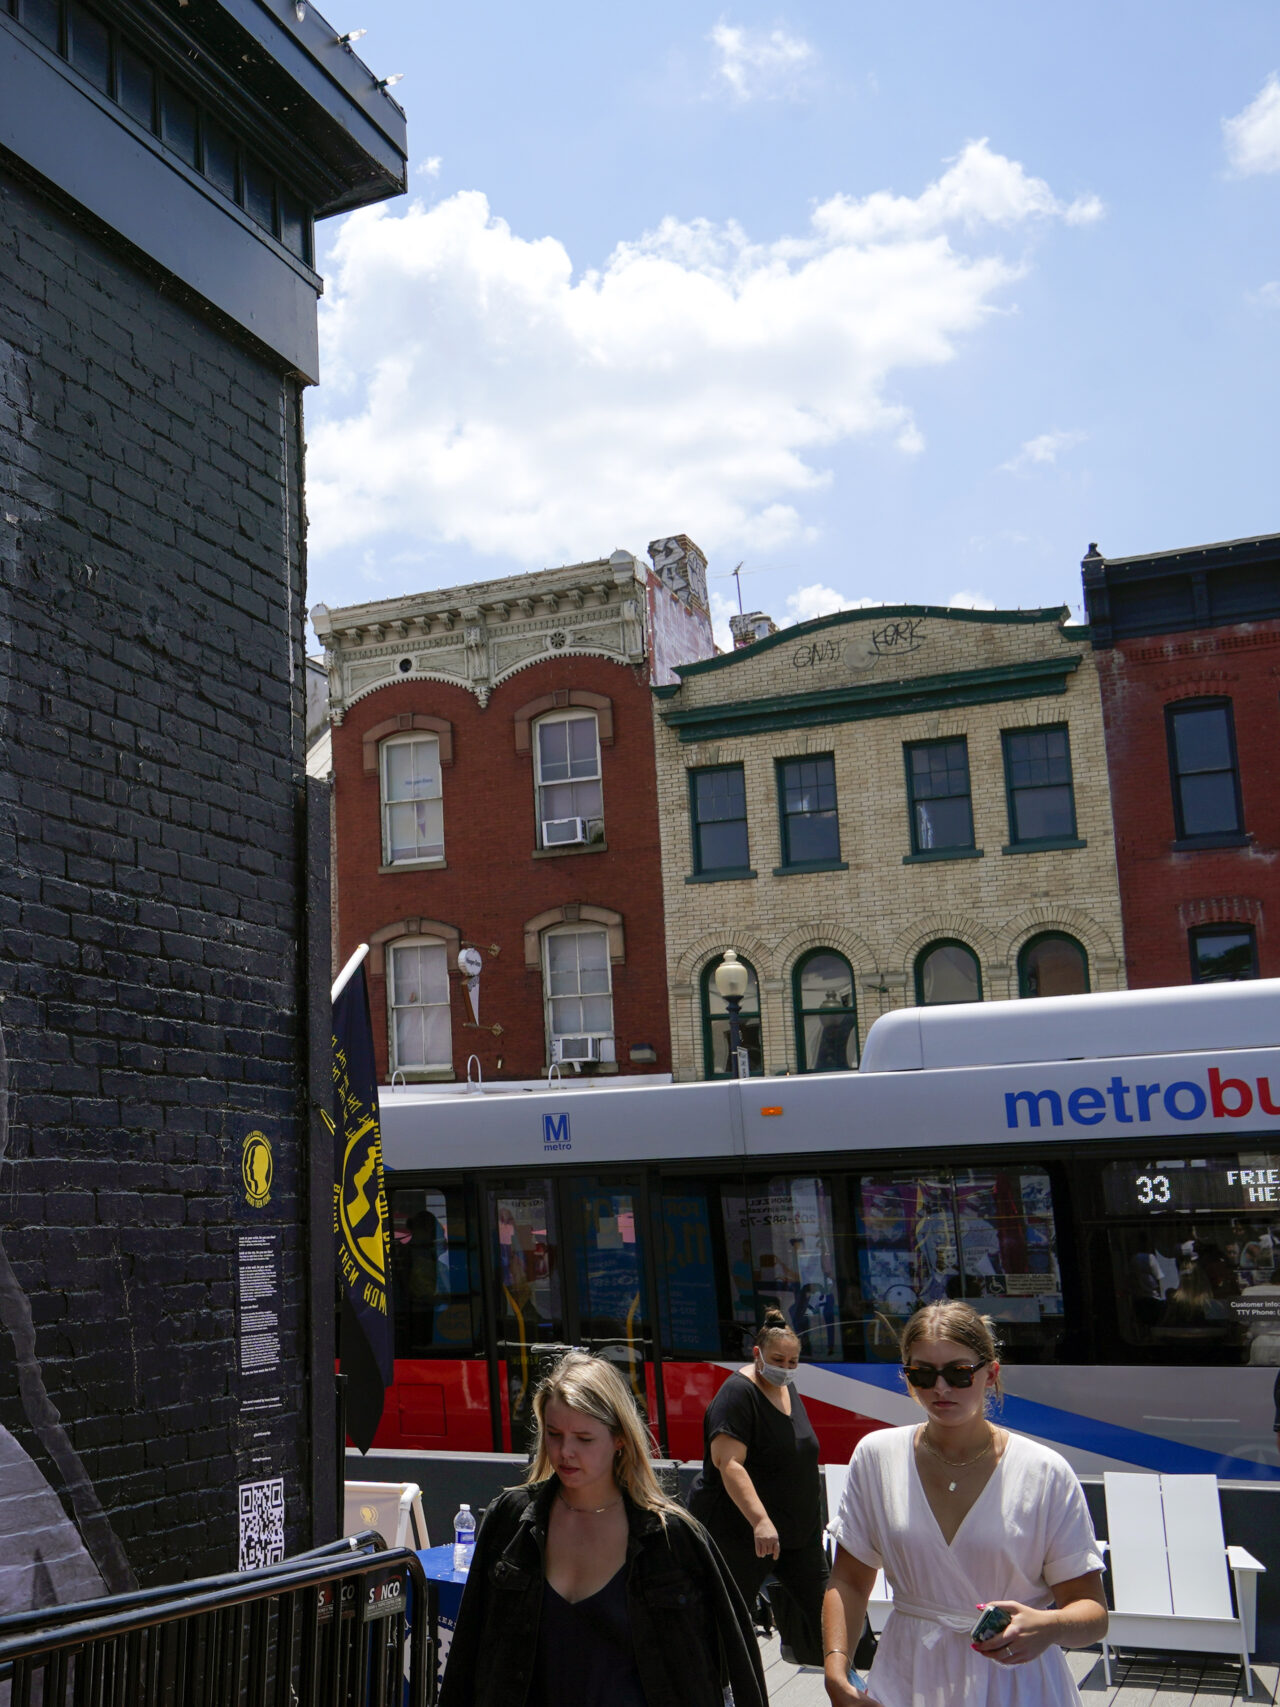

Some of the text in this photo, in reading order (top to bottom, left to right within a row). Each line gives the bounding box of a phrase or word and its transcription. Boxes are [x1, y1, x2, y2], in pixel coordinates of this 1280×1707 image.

[545, 1114, 569, 1141] M
[544, 1143, 572, 1151] metro
[1226, 1169, 1280, 1186] FRIE
[1136, 1175, 1171, 1204] 33
[1249, 1186, 1280, 1202] HE
[338, 1242, 360, 1288] THEM
